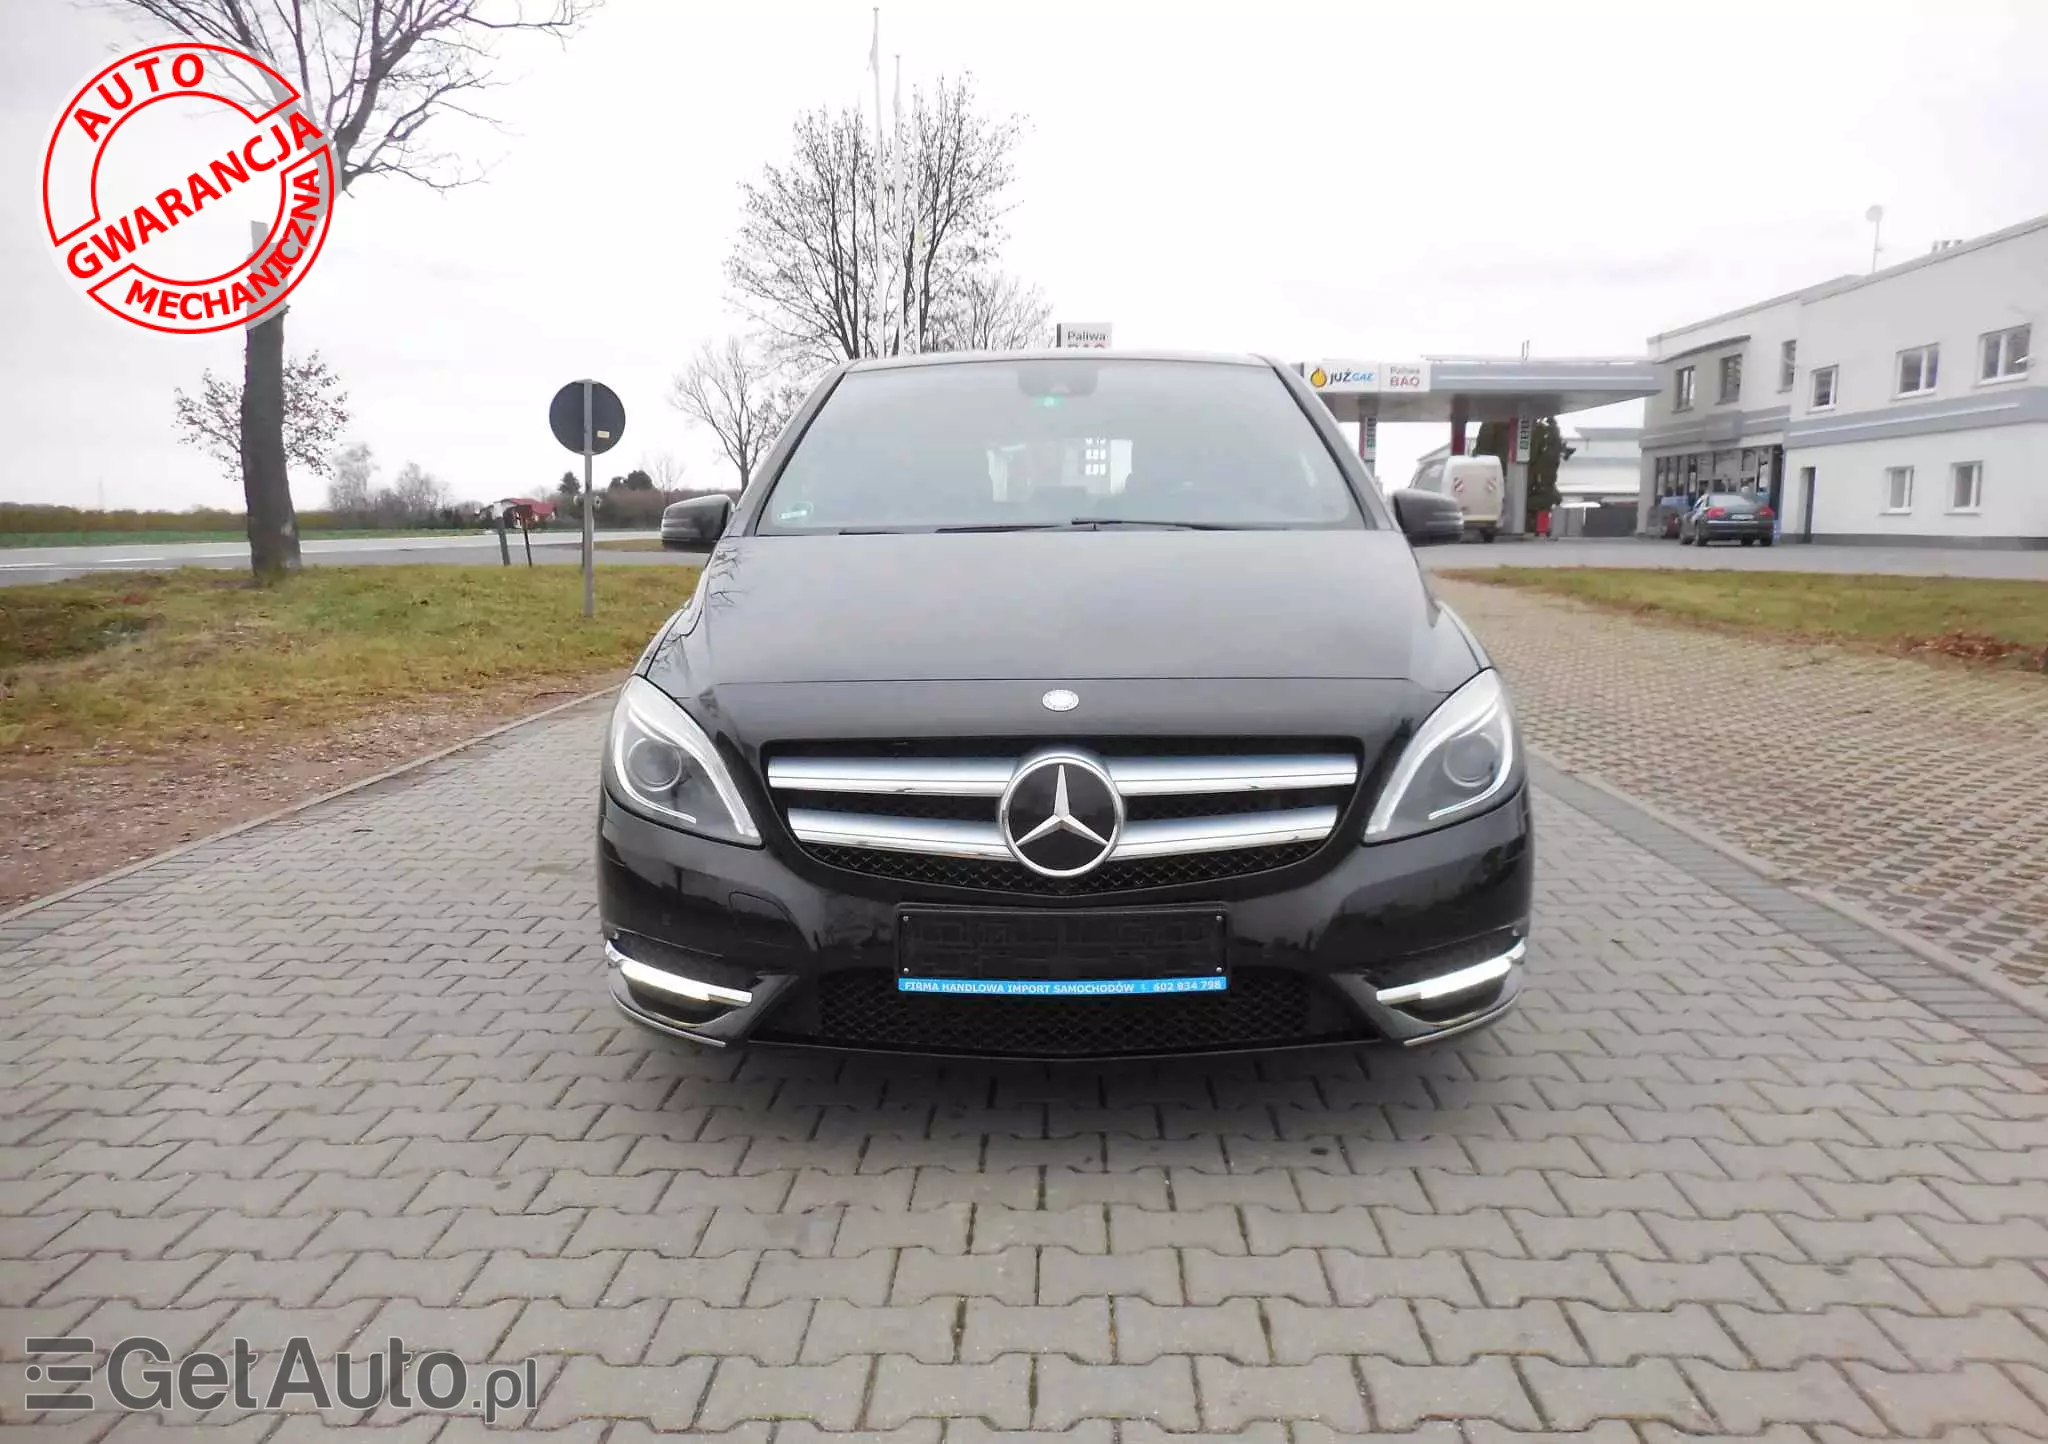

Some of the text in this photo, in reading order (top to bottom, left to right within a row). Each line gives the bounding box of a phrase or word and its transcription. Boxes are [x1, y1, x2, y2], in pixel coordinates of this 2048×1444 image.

[1067, 331, 1106, 341] Paliwa
[904, 981, 940, 991] FIRMA
[942, 983, 1005, 993] HANDLOWA
[1007, 984, 1050, 994] IMPORT
[1053, 981, 1135, 994] SAMOCHODÓW
[1152, 982, 1174, 991] 602
